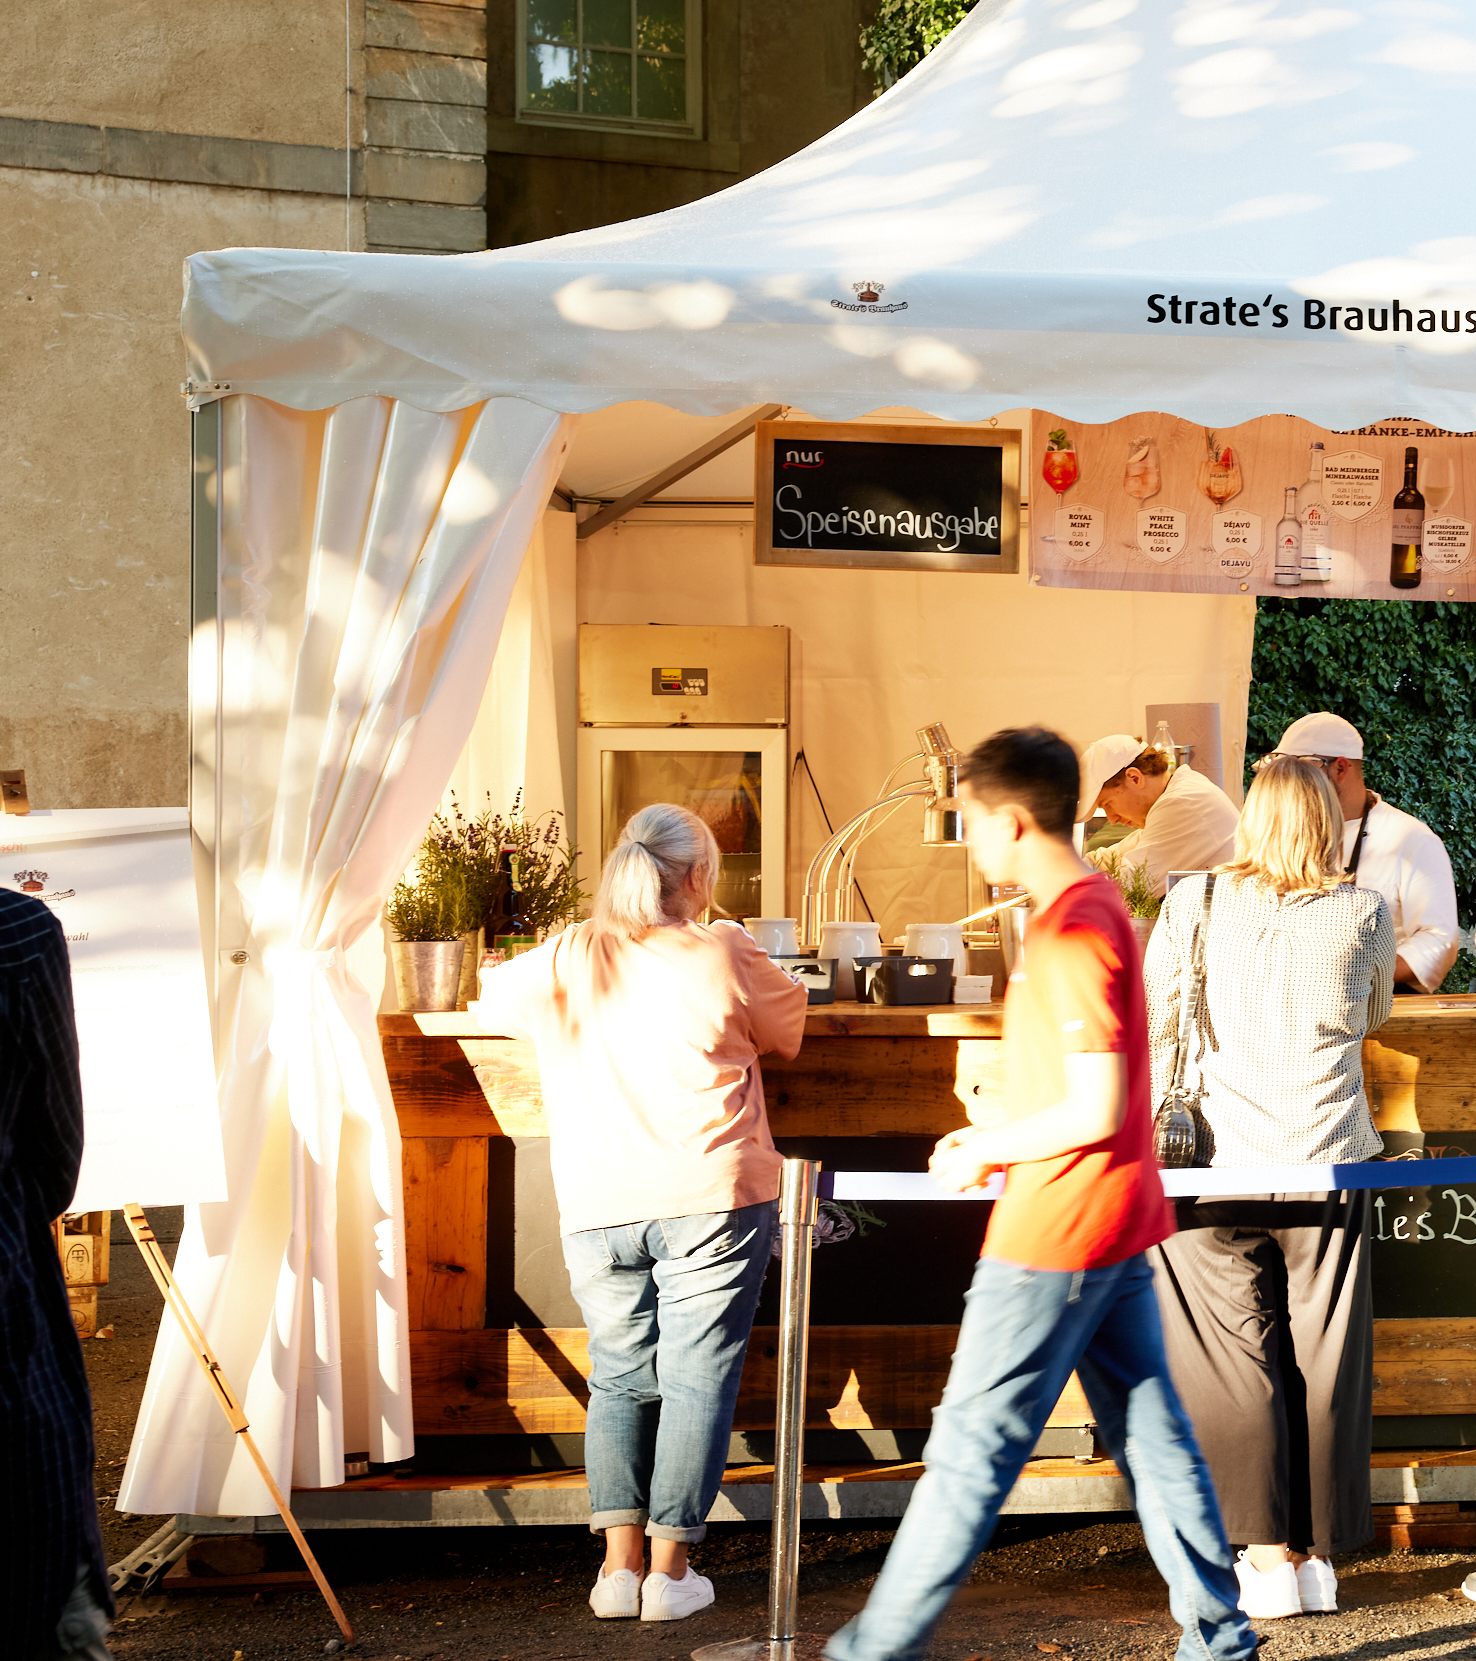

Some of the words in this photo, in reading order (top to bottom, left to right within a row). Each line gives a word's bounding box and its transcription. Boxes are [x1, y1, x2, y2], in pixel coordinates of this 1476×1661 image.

[1146, 293, 1289, 329] Strate's
[786, 450, 824, 463] nur
[776, 484, 999, 552] Speisenausgabe
